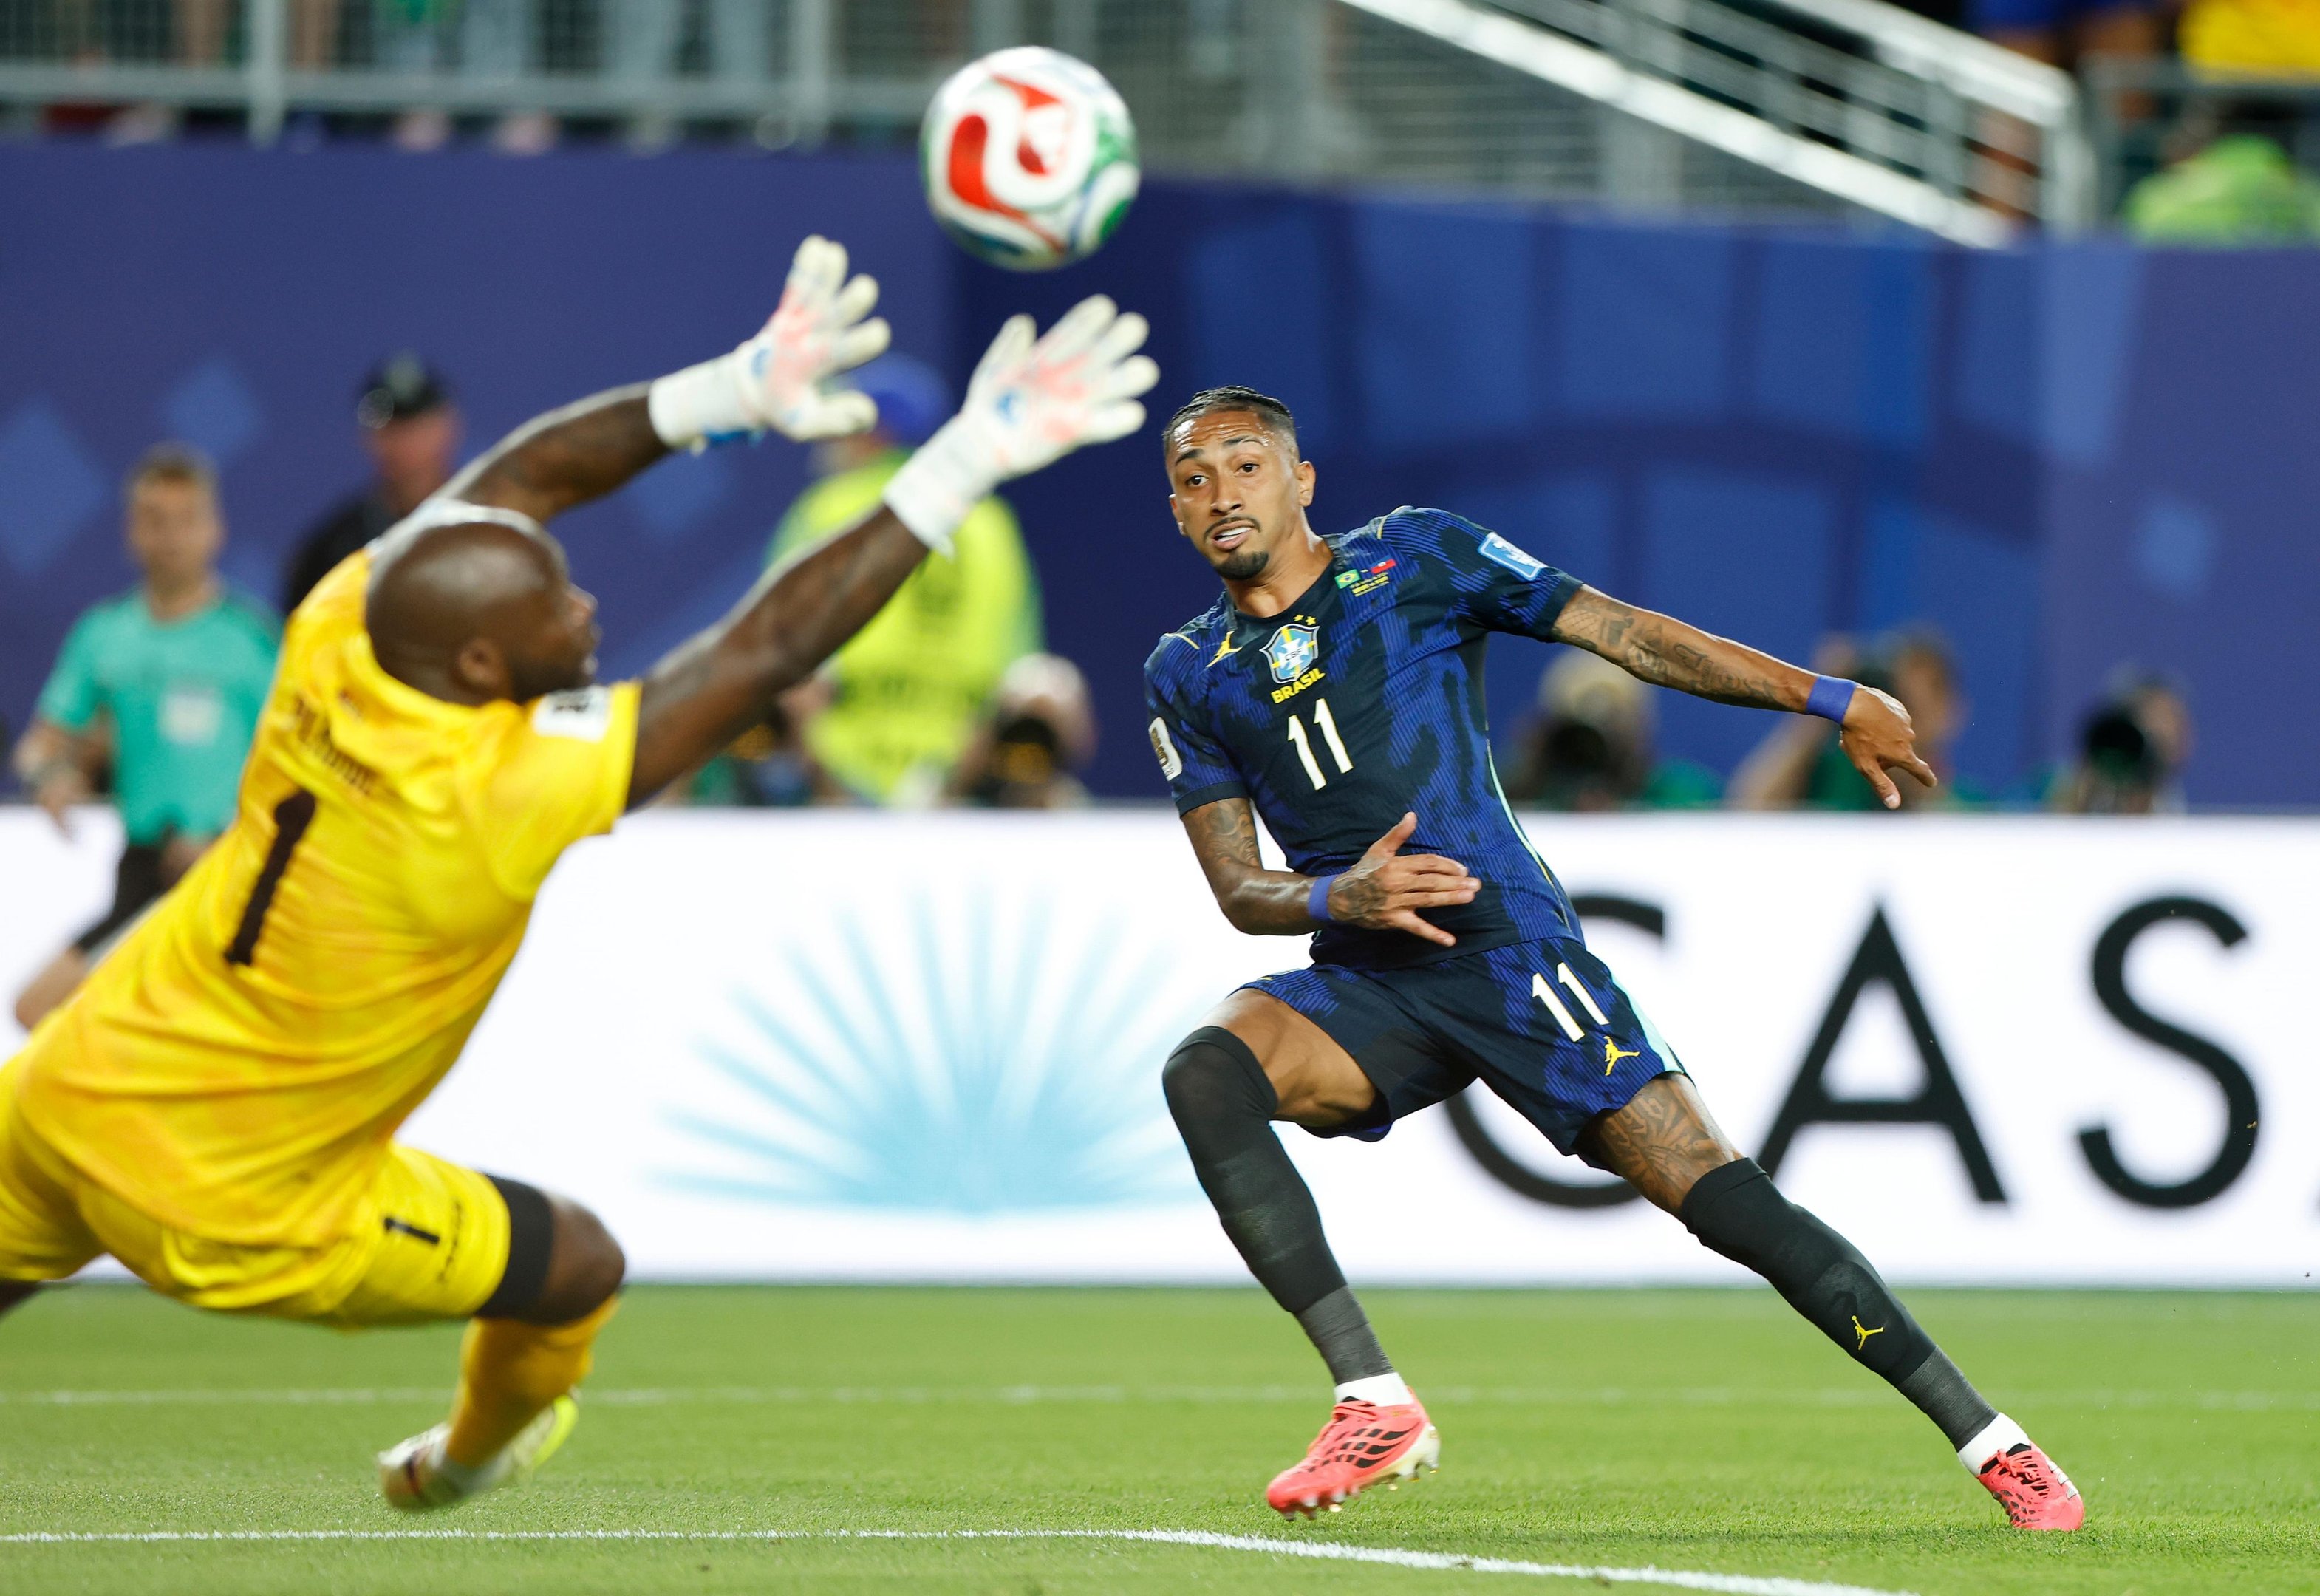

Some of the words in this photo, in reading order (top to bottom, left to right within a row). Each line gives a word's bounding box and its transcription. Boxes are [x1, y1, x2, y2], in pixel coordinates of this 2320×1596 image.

[1271, 668, 1326, 703] BRASIL
[1287, 698, 1354, 791] 11
[224, 788, 316, 966] 1
[1532, 961, 1610, 1043] 11
[1439, 894, 2320, 1209] CAS
[383, 1216, 440, 1245] 1
